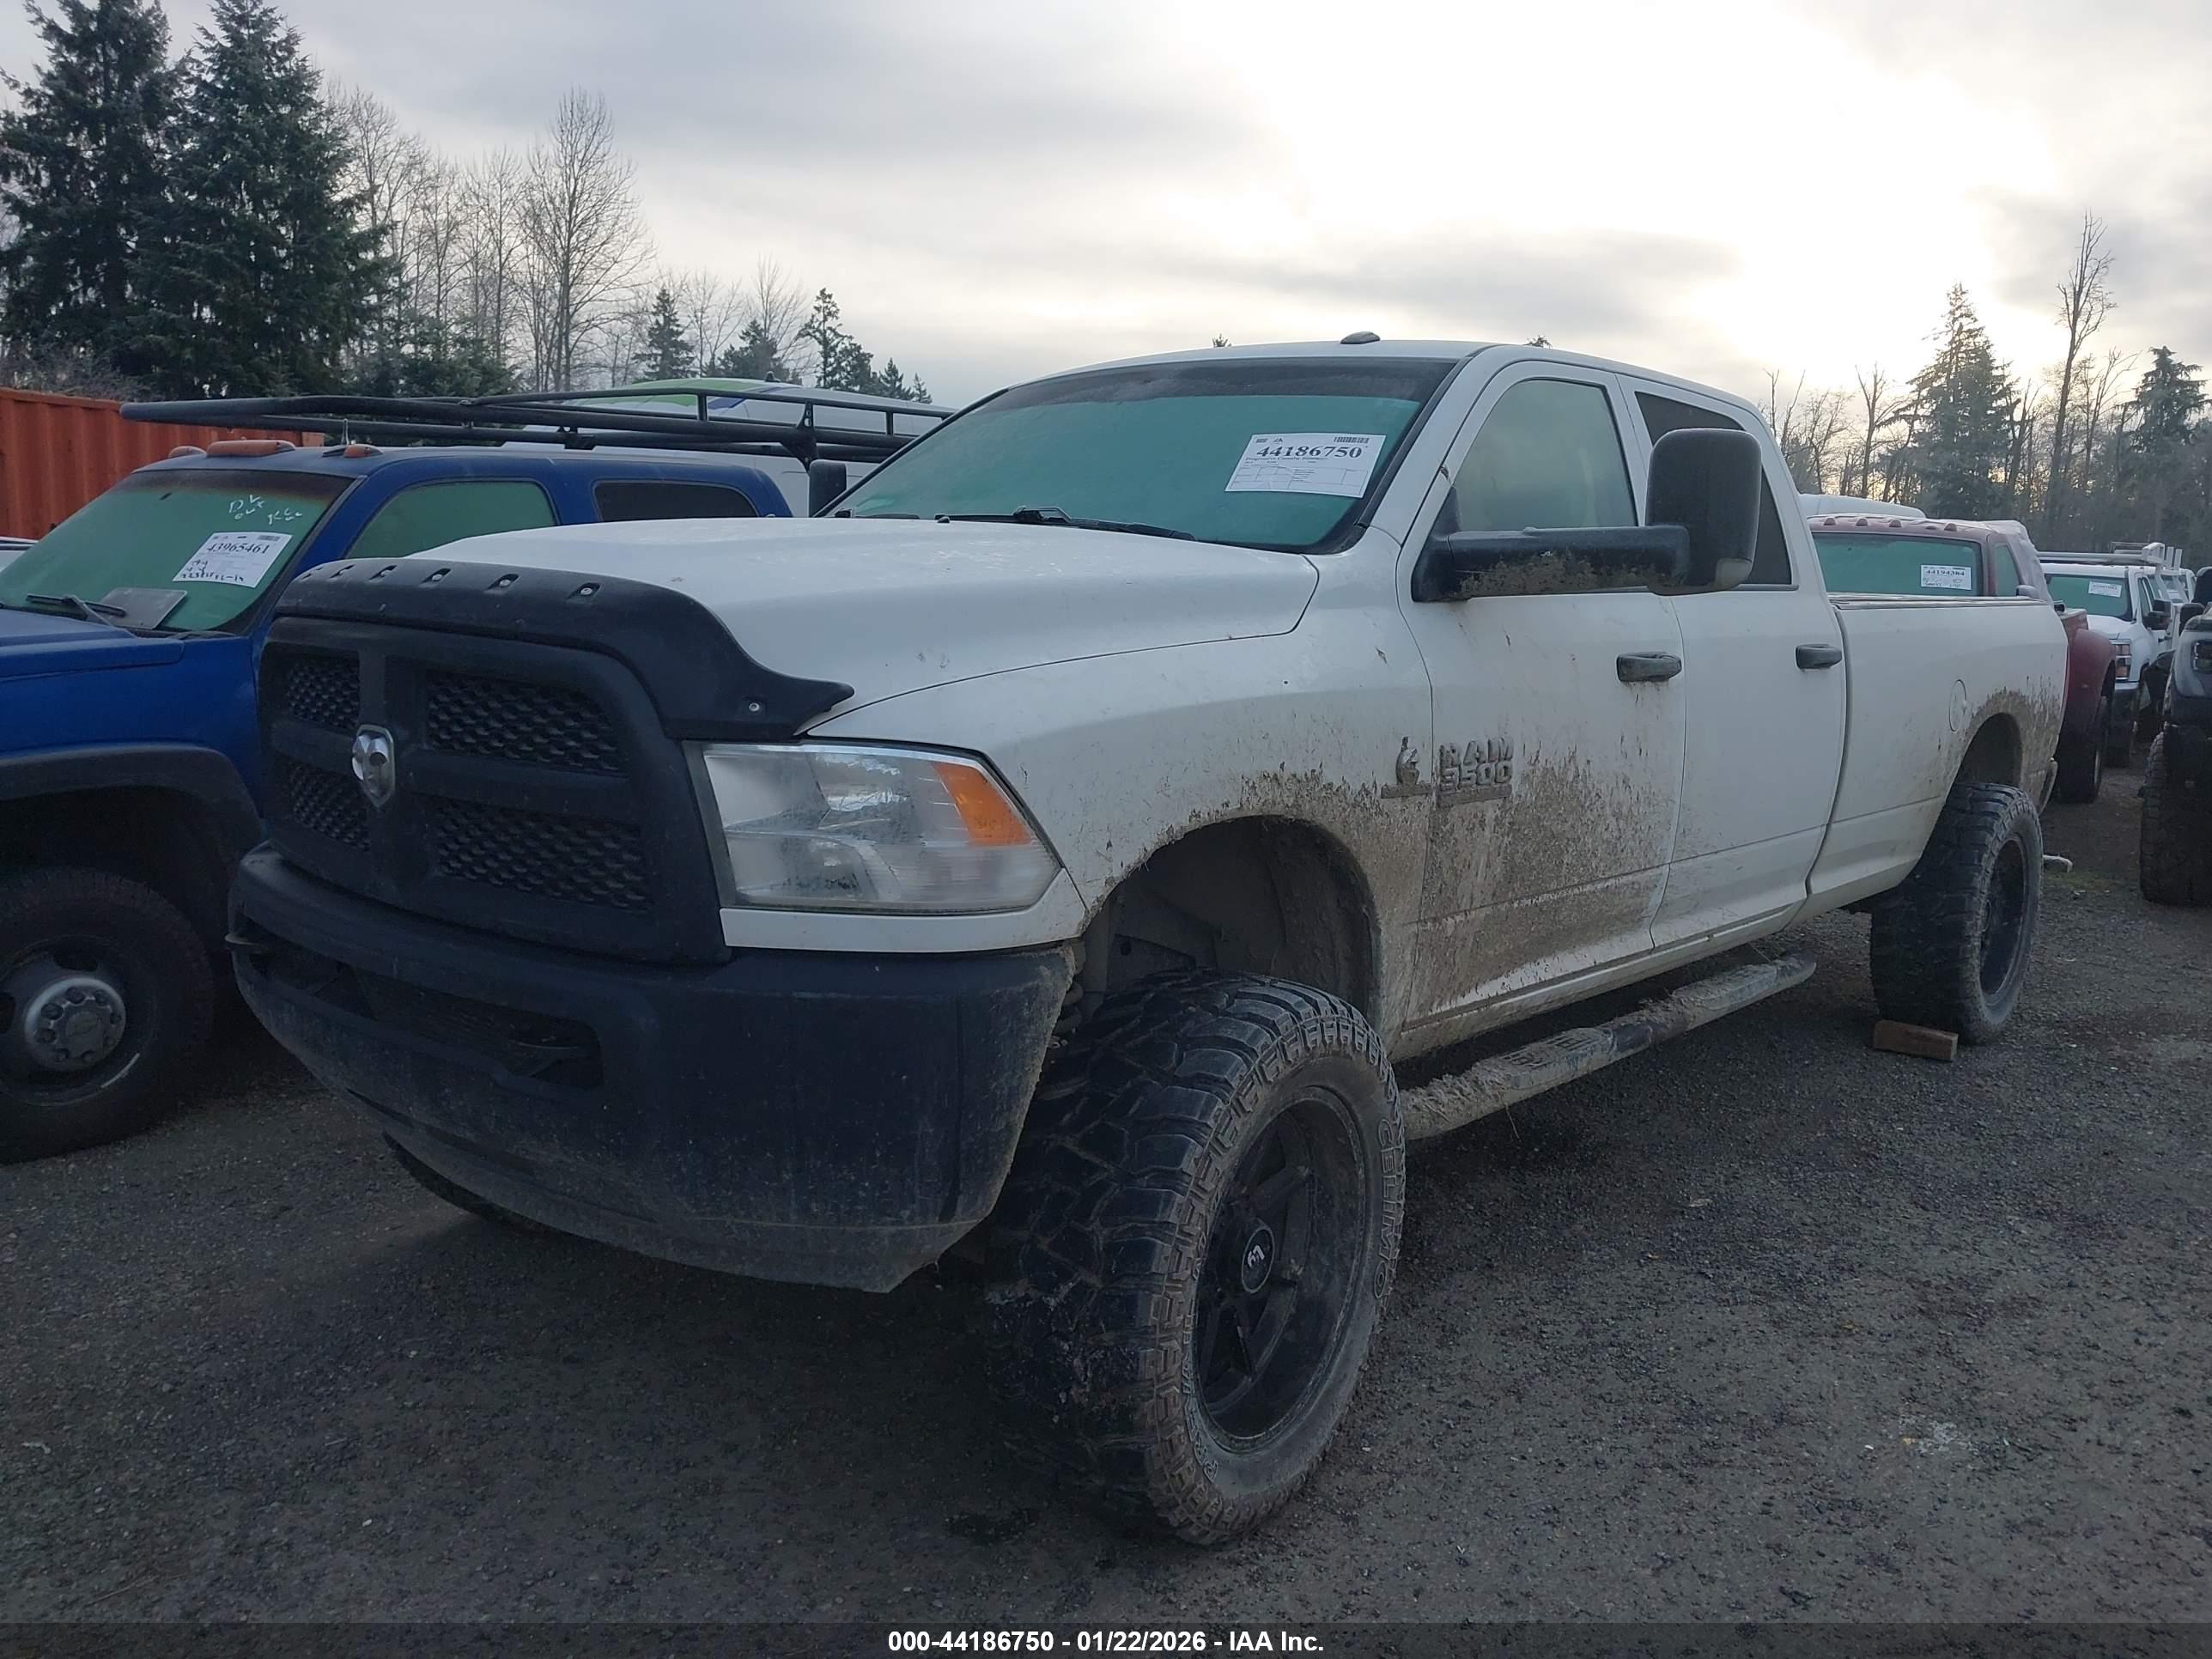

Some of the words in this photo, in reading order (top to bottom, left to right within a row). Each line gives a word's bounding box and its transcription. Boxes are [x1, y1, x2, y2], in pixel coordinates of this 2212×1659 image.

[1256, 446, 1362, 459] 44186750
[207, 543, 270, 554] 43965461
[1439, 738, 1514, 767] RAM
